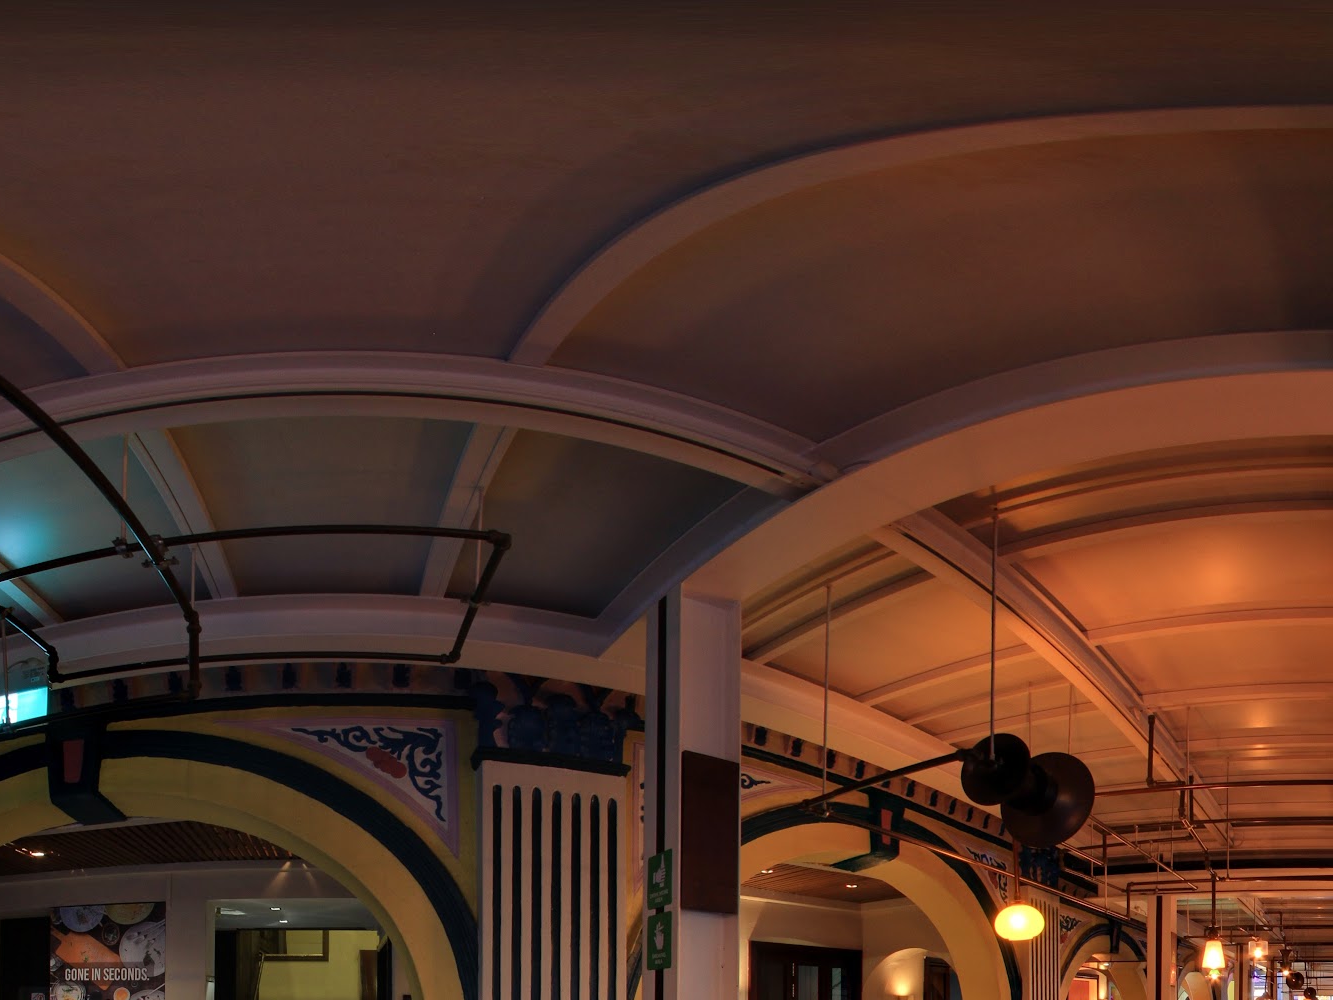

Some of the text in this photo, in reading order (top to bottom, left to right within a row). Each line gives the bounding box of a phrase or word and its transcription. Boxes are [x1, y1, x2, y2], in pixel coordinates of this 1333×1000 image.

[65, 967, 150, 981] GONE IN SECONDS.
